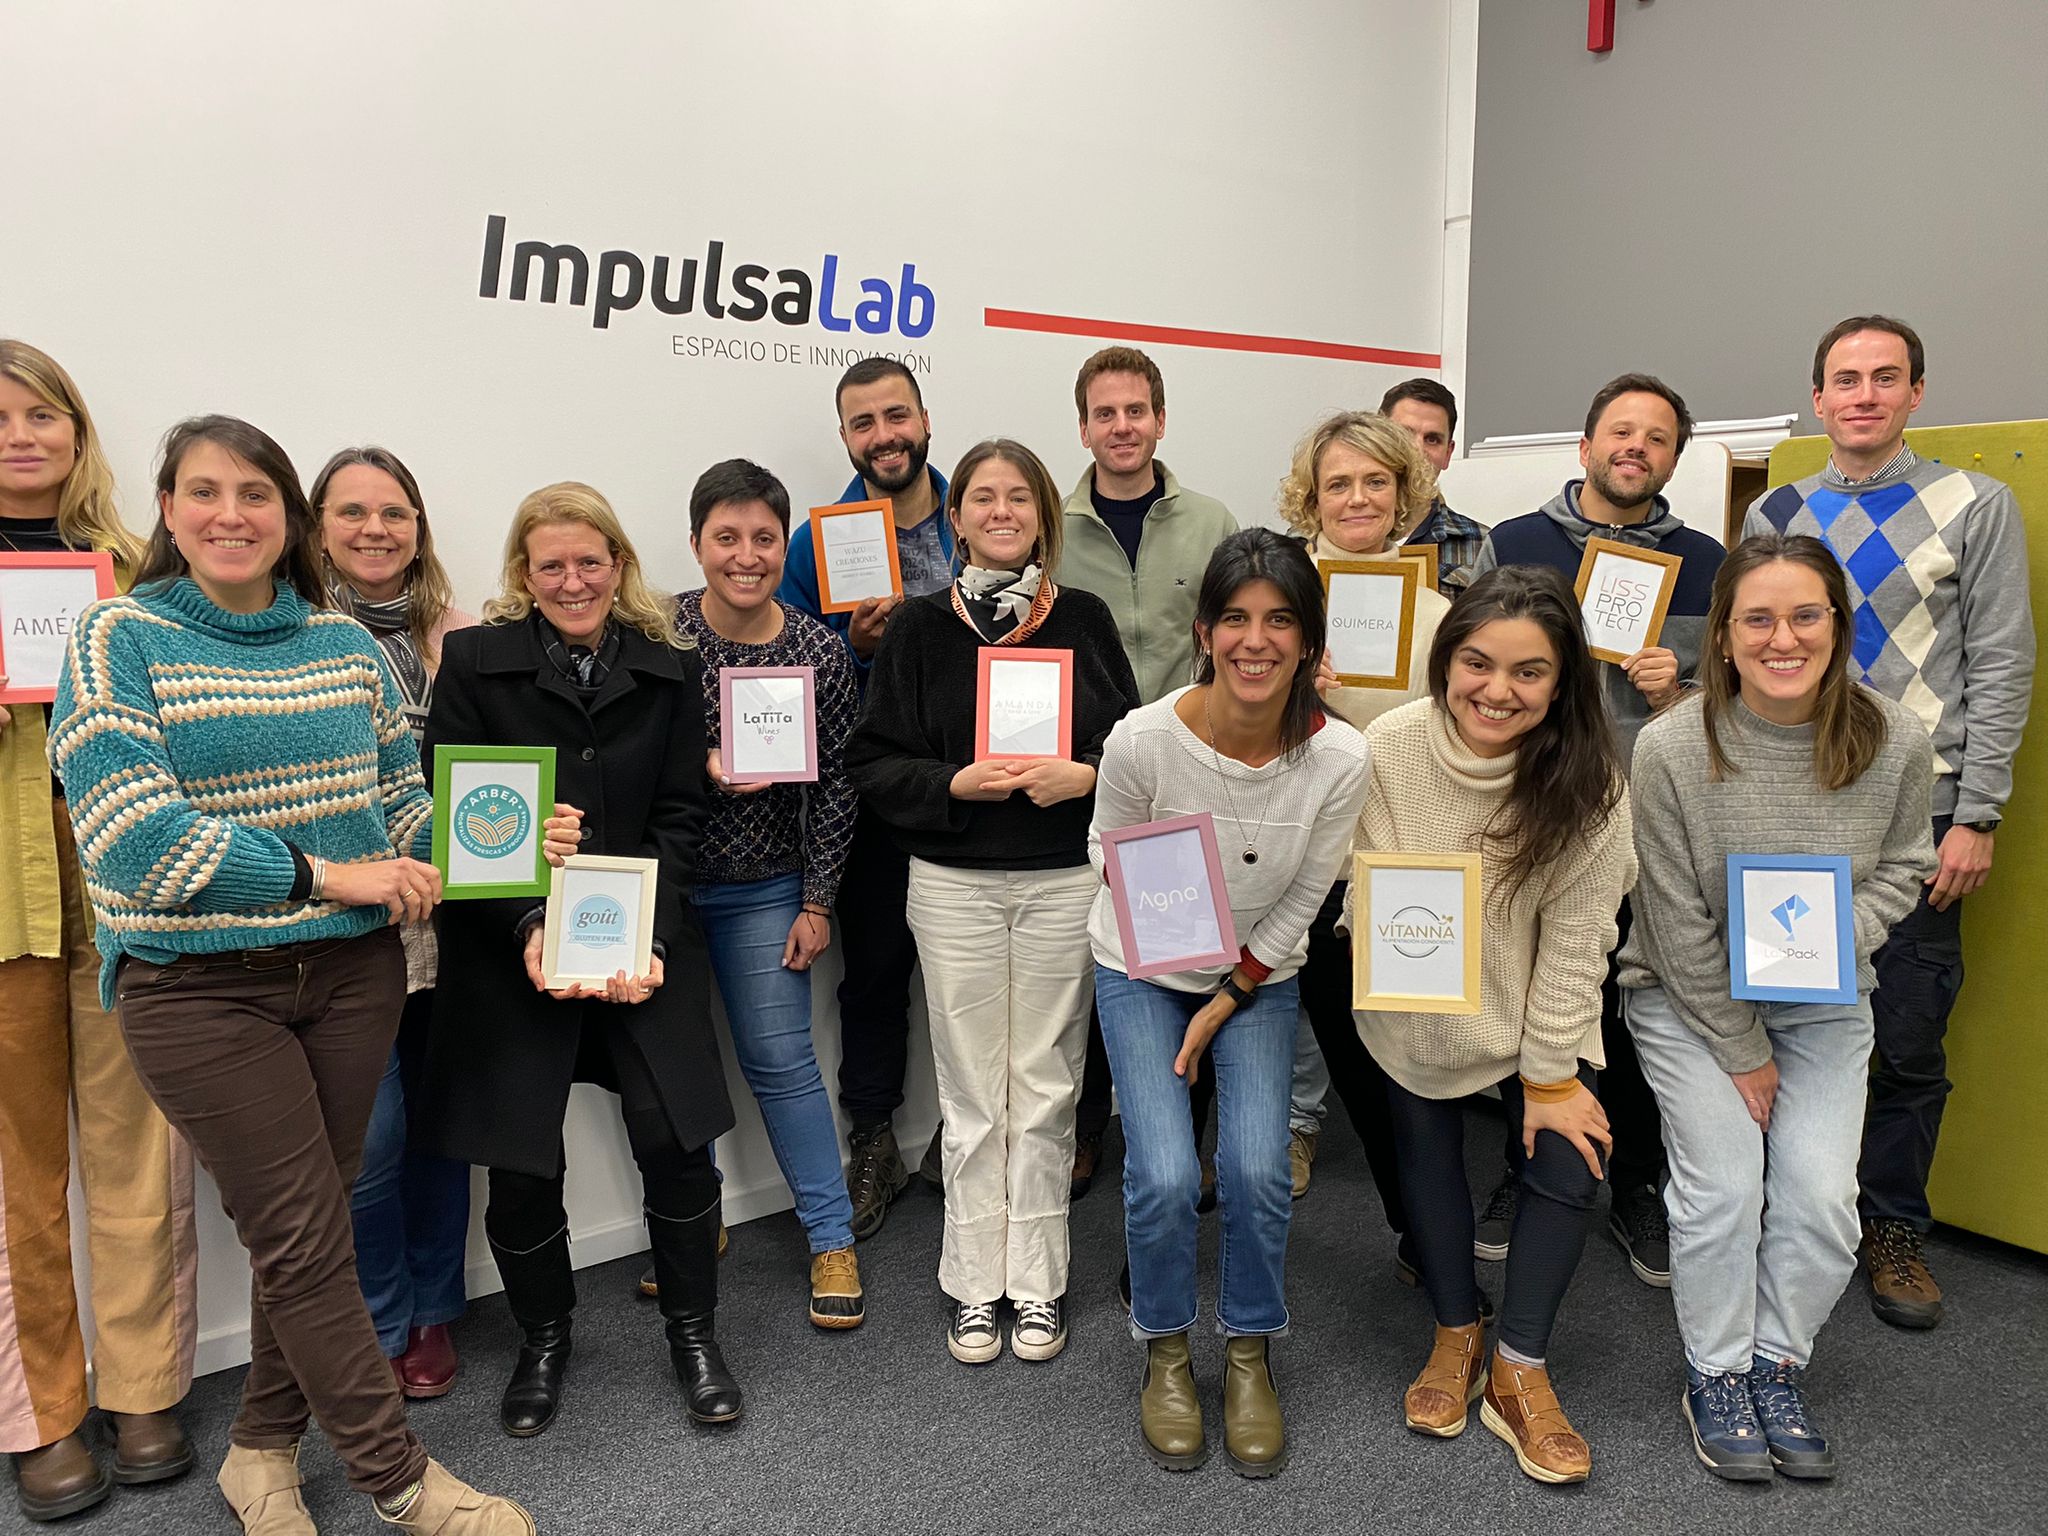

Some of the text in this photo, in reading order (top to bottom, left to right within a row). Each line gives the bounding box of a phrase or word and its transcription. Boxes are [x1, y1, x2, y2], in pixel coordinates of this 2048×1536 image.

[479, 214, 936, 339] ImpulsaLab
[672, 335, 766, 361] ESPACIO
[773, 343, 801, 364] DE
[1600, 576, 1650, 601] LISS
[1595, 593, 1643, 618] PRO
[13, 608, 75, 636] AMÉ
[1331, 616, 1394, 631] QUIMERA
[1594, 609, 1640, 632] TECT
[756, 724, 780, 735] Wines
[468, 788, 519, 807] ARBER
[473, 846, 502, 855] FRESCAS
[1138, 886, 1200, 912] Agna
[576, 908, 619, 928] goût
[574, 934, 600, 942] GLUTEN
